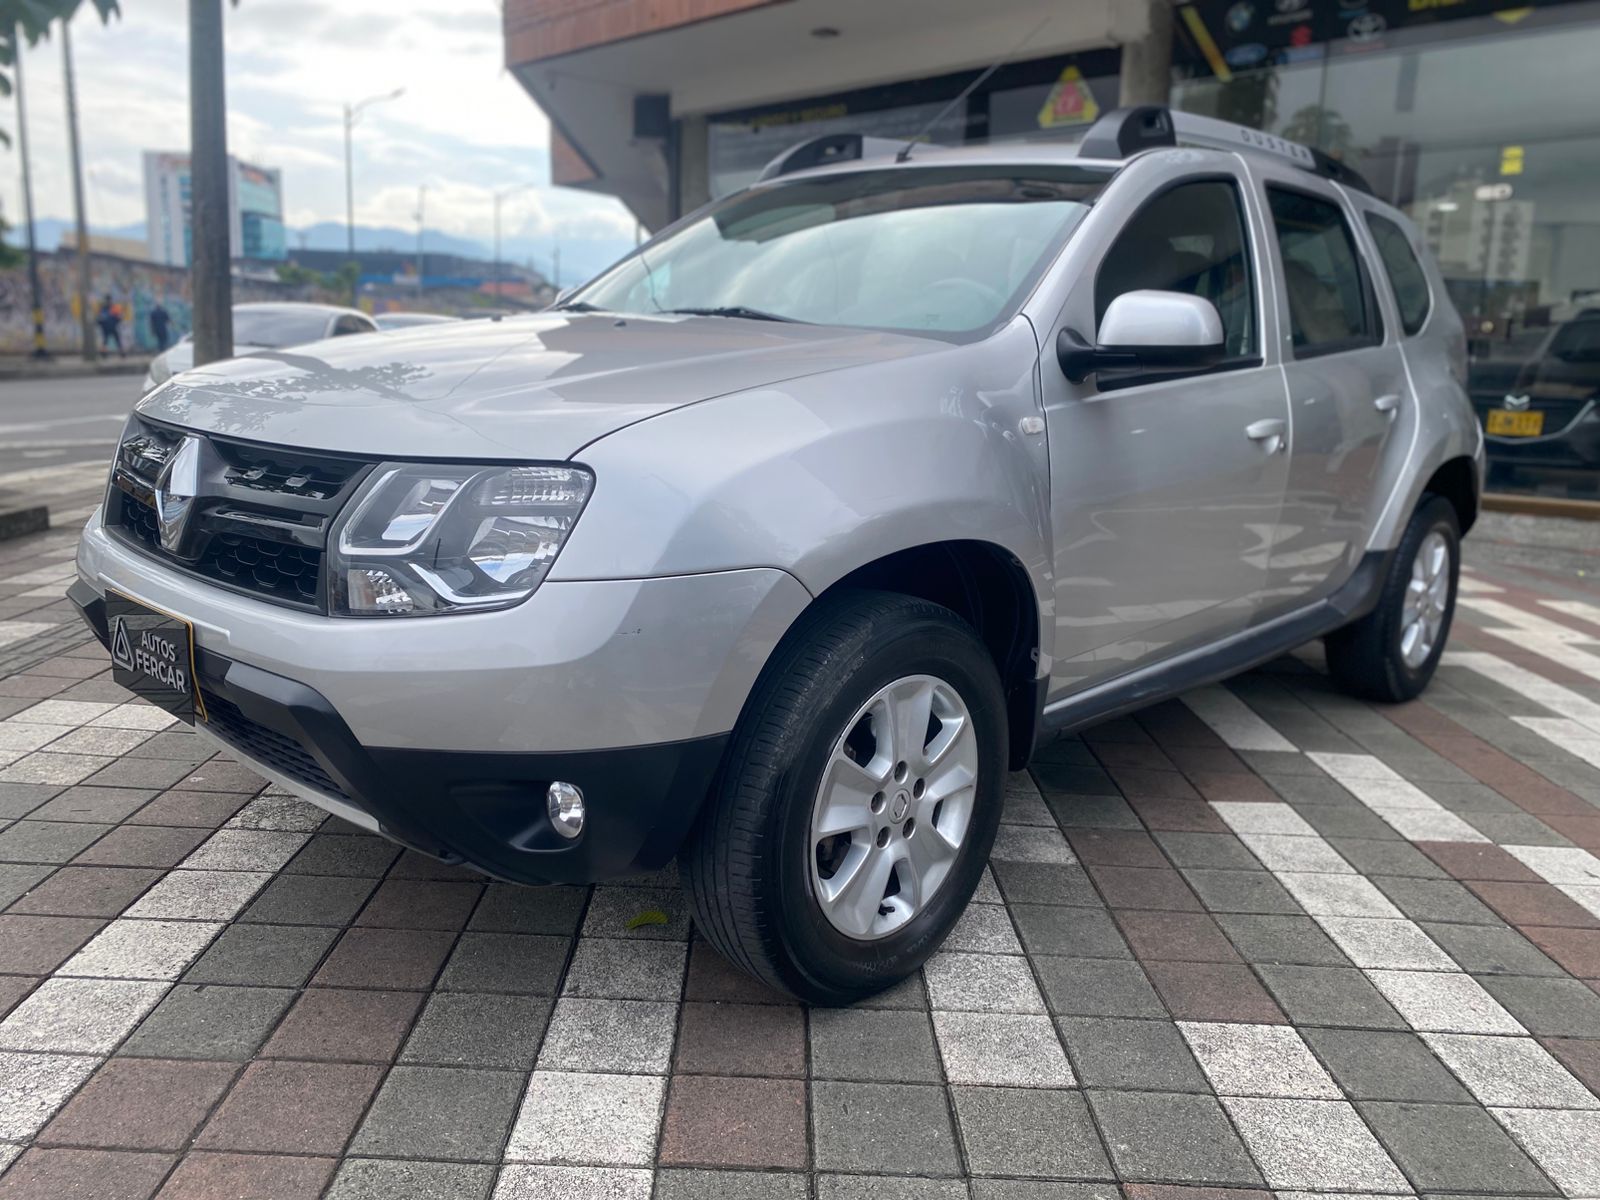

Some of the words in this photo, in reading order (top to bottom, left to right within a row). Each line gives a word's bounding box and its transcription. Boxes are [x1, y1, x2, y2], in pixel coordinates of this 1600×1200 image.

[1240, 129, 1308, 159] DUSTER
[141, 630, 176, 662] AUTOS
[135, 648, 186, 694] FERCAR
